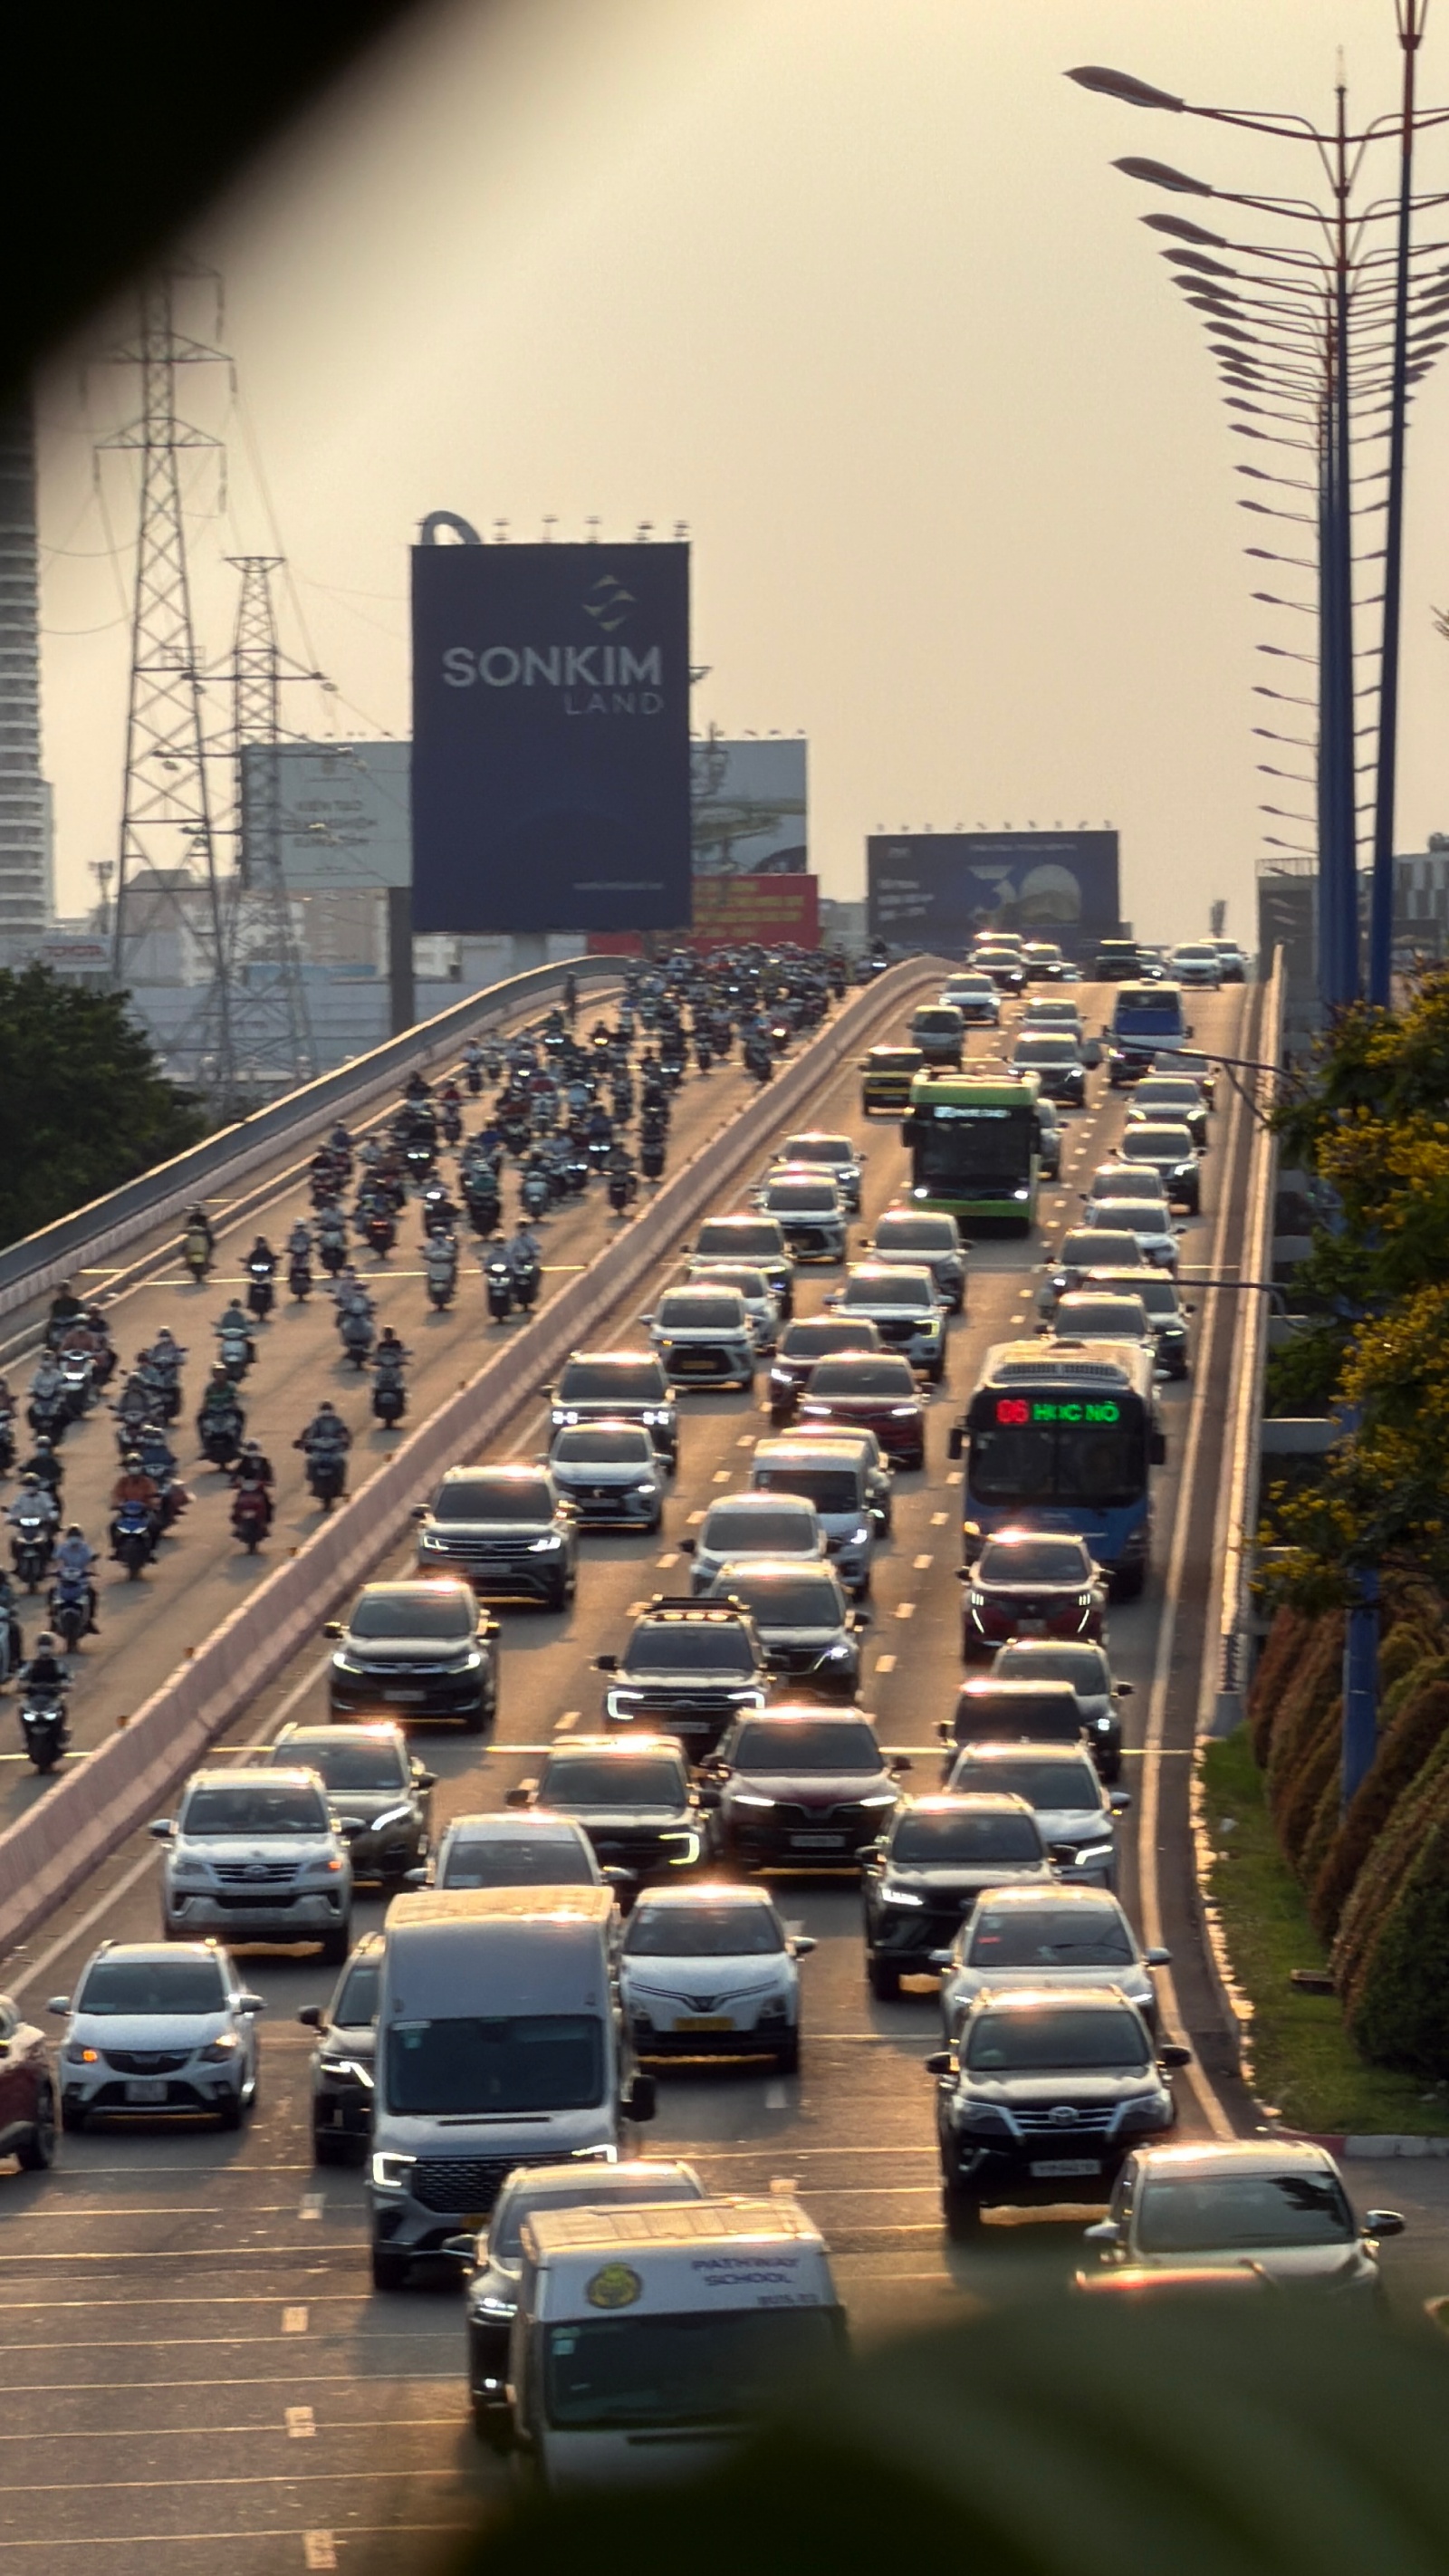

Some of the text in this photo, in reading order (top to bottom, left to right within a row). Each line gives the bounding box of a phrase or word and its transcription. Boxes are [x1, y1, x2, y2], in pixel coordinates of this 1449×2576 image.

[442, 645, 662, 687] SONKIM
[563, 691, 665, 716] LAND
[704, 2272, 792, 2286] SCHOOL
